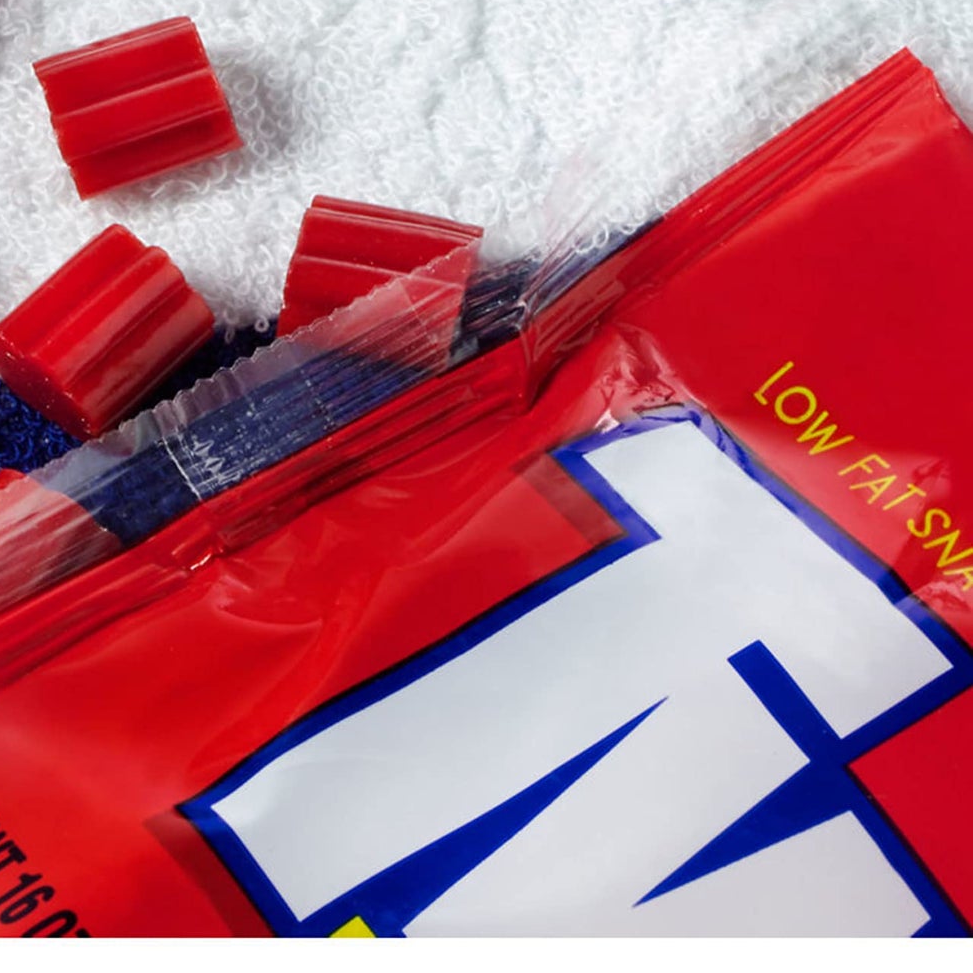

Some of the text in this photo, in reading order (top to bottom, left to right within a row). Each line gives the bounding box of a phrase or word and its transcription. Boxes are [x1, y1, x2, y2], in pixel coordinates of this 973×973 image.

[754, 361, 854, 455] LOW
[838, 454, 926, 511] FAT
[20, 909, 92, 938] O
